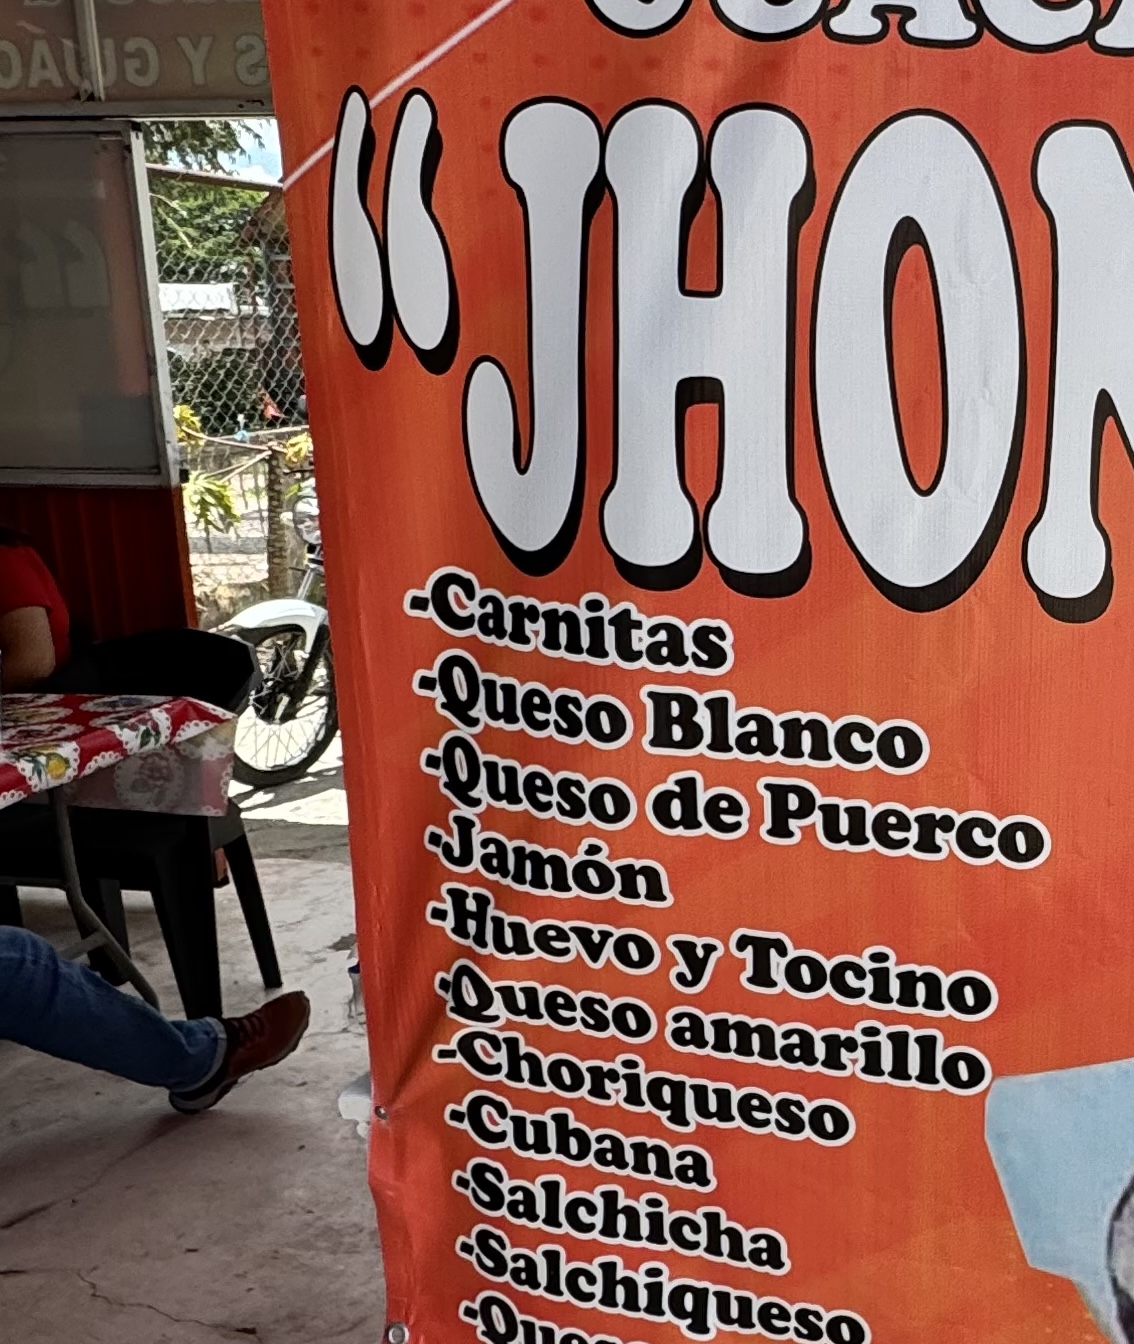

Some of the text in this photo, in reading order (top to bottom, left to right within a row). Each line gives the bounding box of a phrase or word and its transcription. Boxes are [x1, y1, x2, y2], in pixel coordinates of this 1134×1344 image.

[408, 570, 730, 671] -Carnitas
[417, 652, 926, 772] -Queso Blanco
[425, 733, 1048, 864] -Queso de Puerco
[428, 815, 669, 904] -Jamón
[430, 888, 993, 1017] -Huevo y Tocino
[438, 964, 989, 1092] -Queso amarillo
[437, 1030, 852, 1142] -Choriqueso
[448, 1094, 713, 1188] -Cubana
[455, 1161, 787, 1272] -Salchicha
